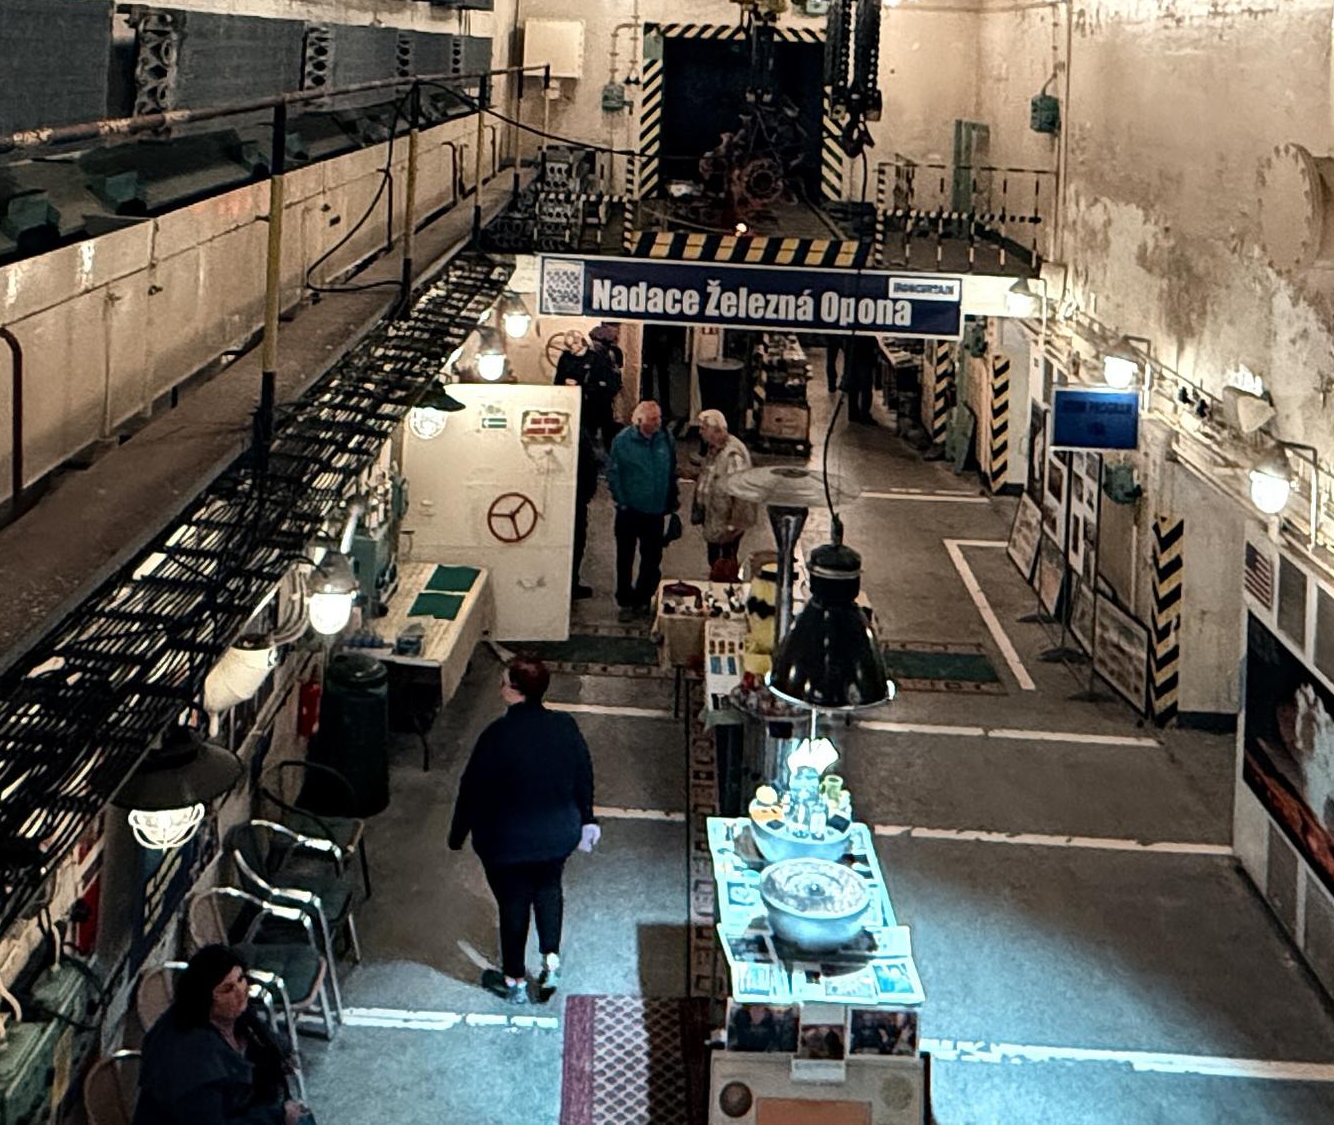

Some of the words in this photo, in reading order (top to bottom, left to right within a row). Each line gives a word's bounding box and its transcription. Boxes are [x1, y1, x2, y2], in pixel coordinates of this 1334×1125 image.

[592, 279, 699, 315] Nadace
[704, 279, 813, 323] Železná
[820, 290, 912, 327] Opona
